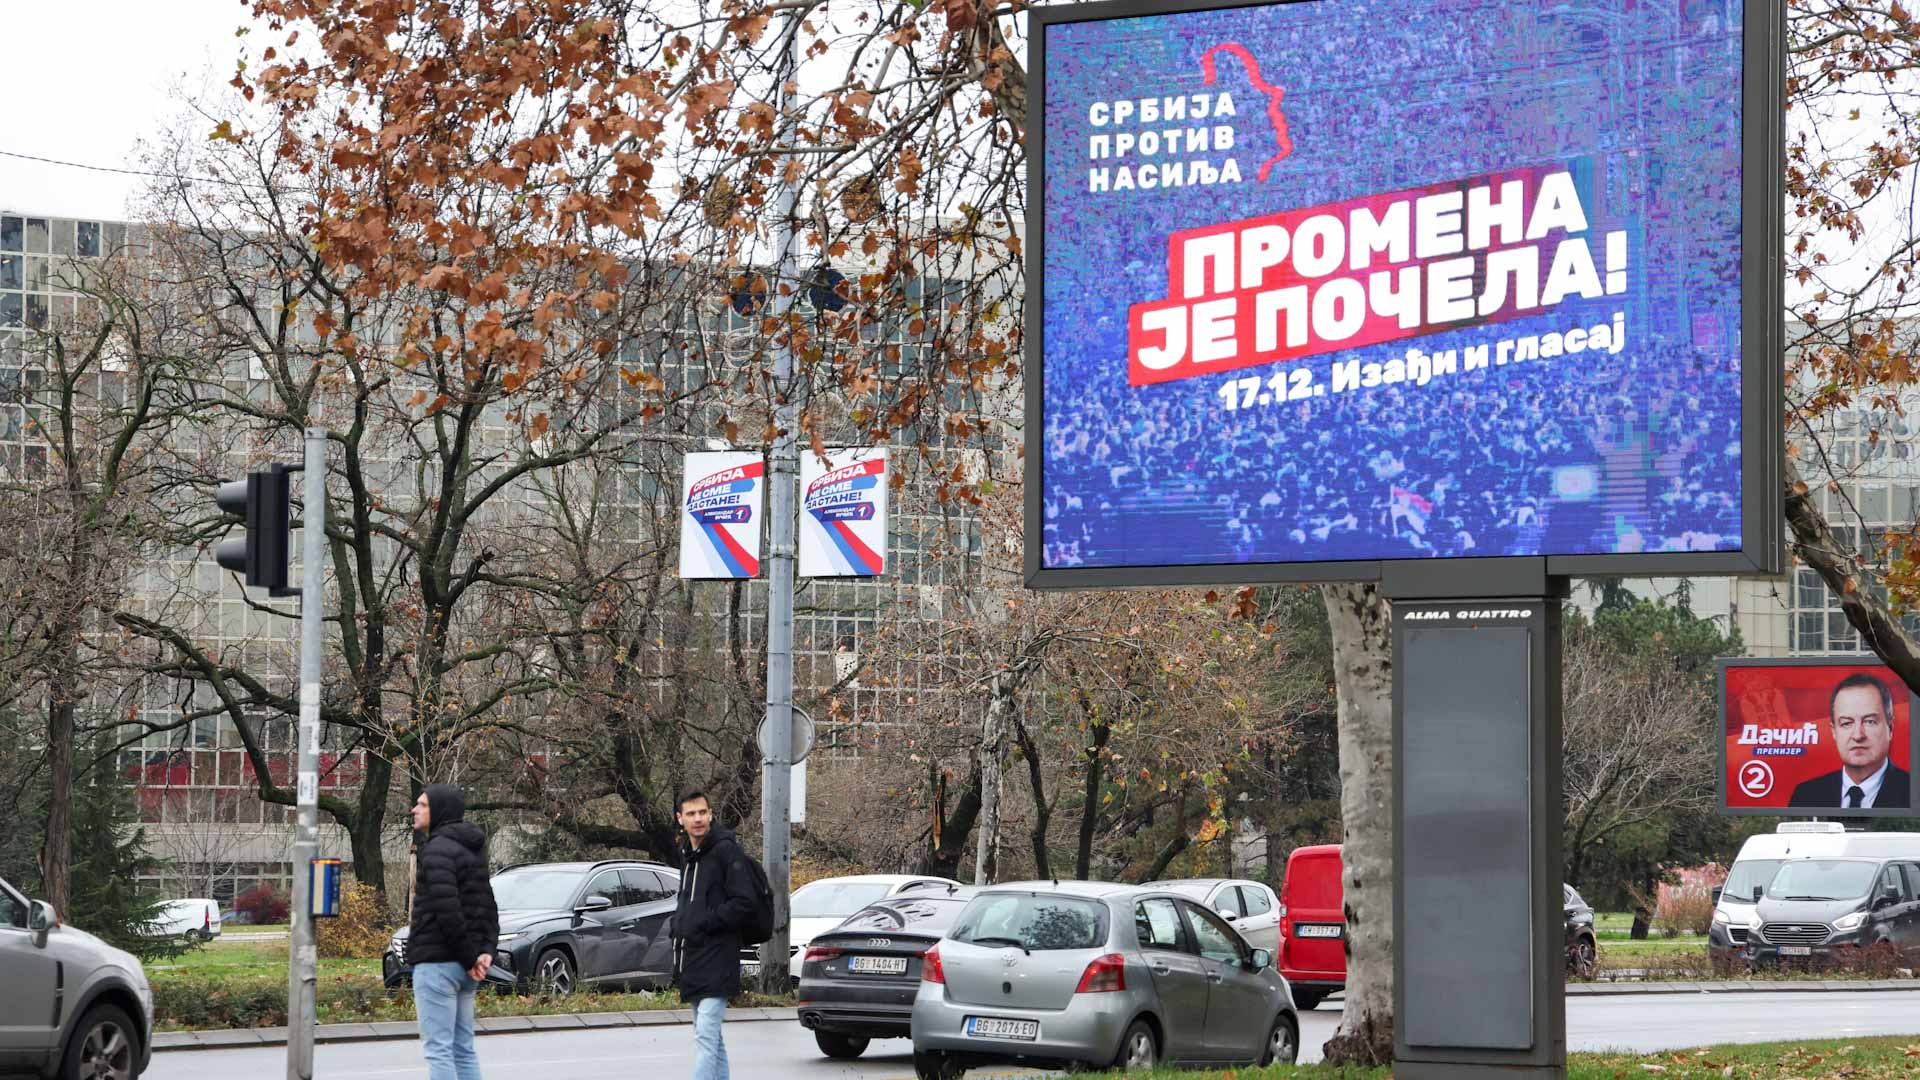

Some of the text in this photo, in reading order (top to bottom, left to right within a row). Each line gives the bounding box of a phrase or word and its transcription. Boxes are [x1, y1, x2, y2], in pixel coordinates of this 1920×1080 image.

[1089, 92, 1236, 126] СРБИЈА
[1089, 125, 1235, 160] ПРОТИВ
[1089, 158, 1242, 193] НАСИЉА
[1183, 171, 1588, 300] ПРОМЕНА
[1137, 230, 1627, 370] ЈЕ ПОЧЕЛА!
[1218, 311, 1625, 411] 17.12. Изађи и гласај
[693, 468, 745, 492] СРБИЈА
[811, 464, 867, 490] СРБИЈА
[691, 482, 731, 502] НЕ СМЕ
[810, 479, 853, 500] НЕ СМЕ
[818, 491, 862, 506] СТАНЕ!
[699, 495, 740, 508] СТАНЕ!
[1404, 609, 1532, 620] ALMA QUATTRO
[1737, 722, 1819, 745] Дачић
[1756, 747, 1802, 755] ПРЕМИЈЕР
[1746, 767, 1766, 789] 2
[854, 958, 865, 969] BG
[976, 1019, 988, 1032] BG
